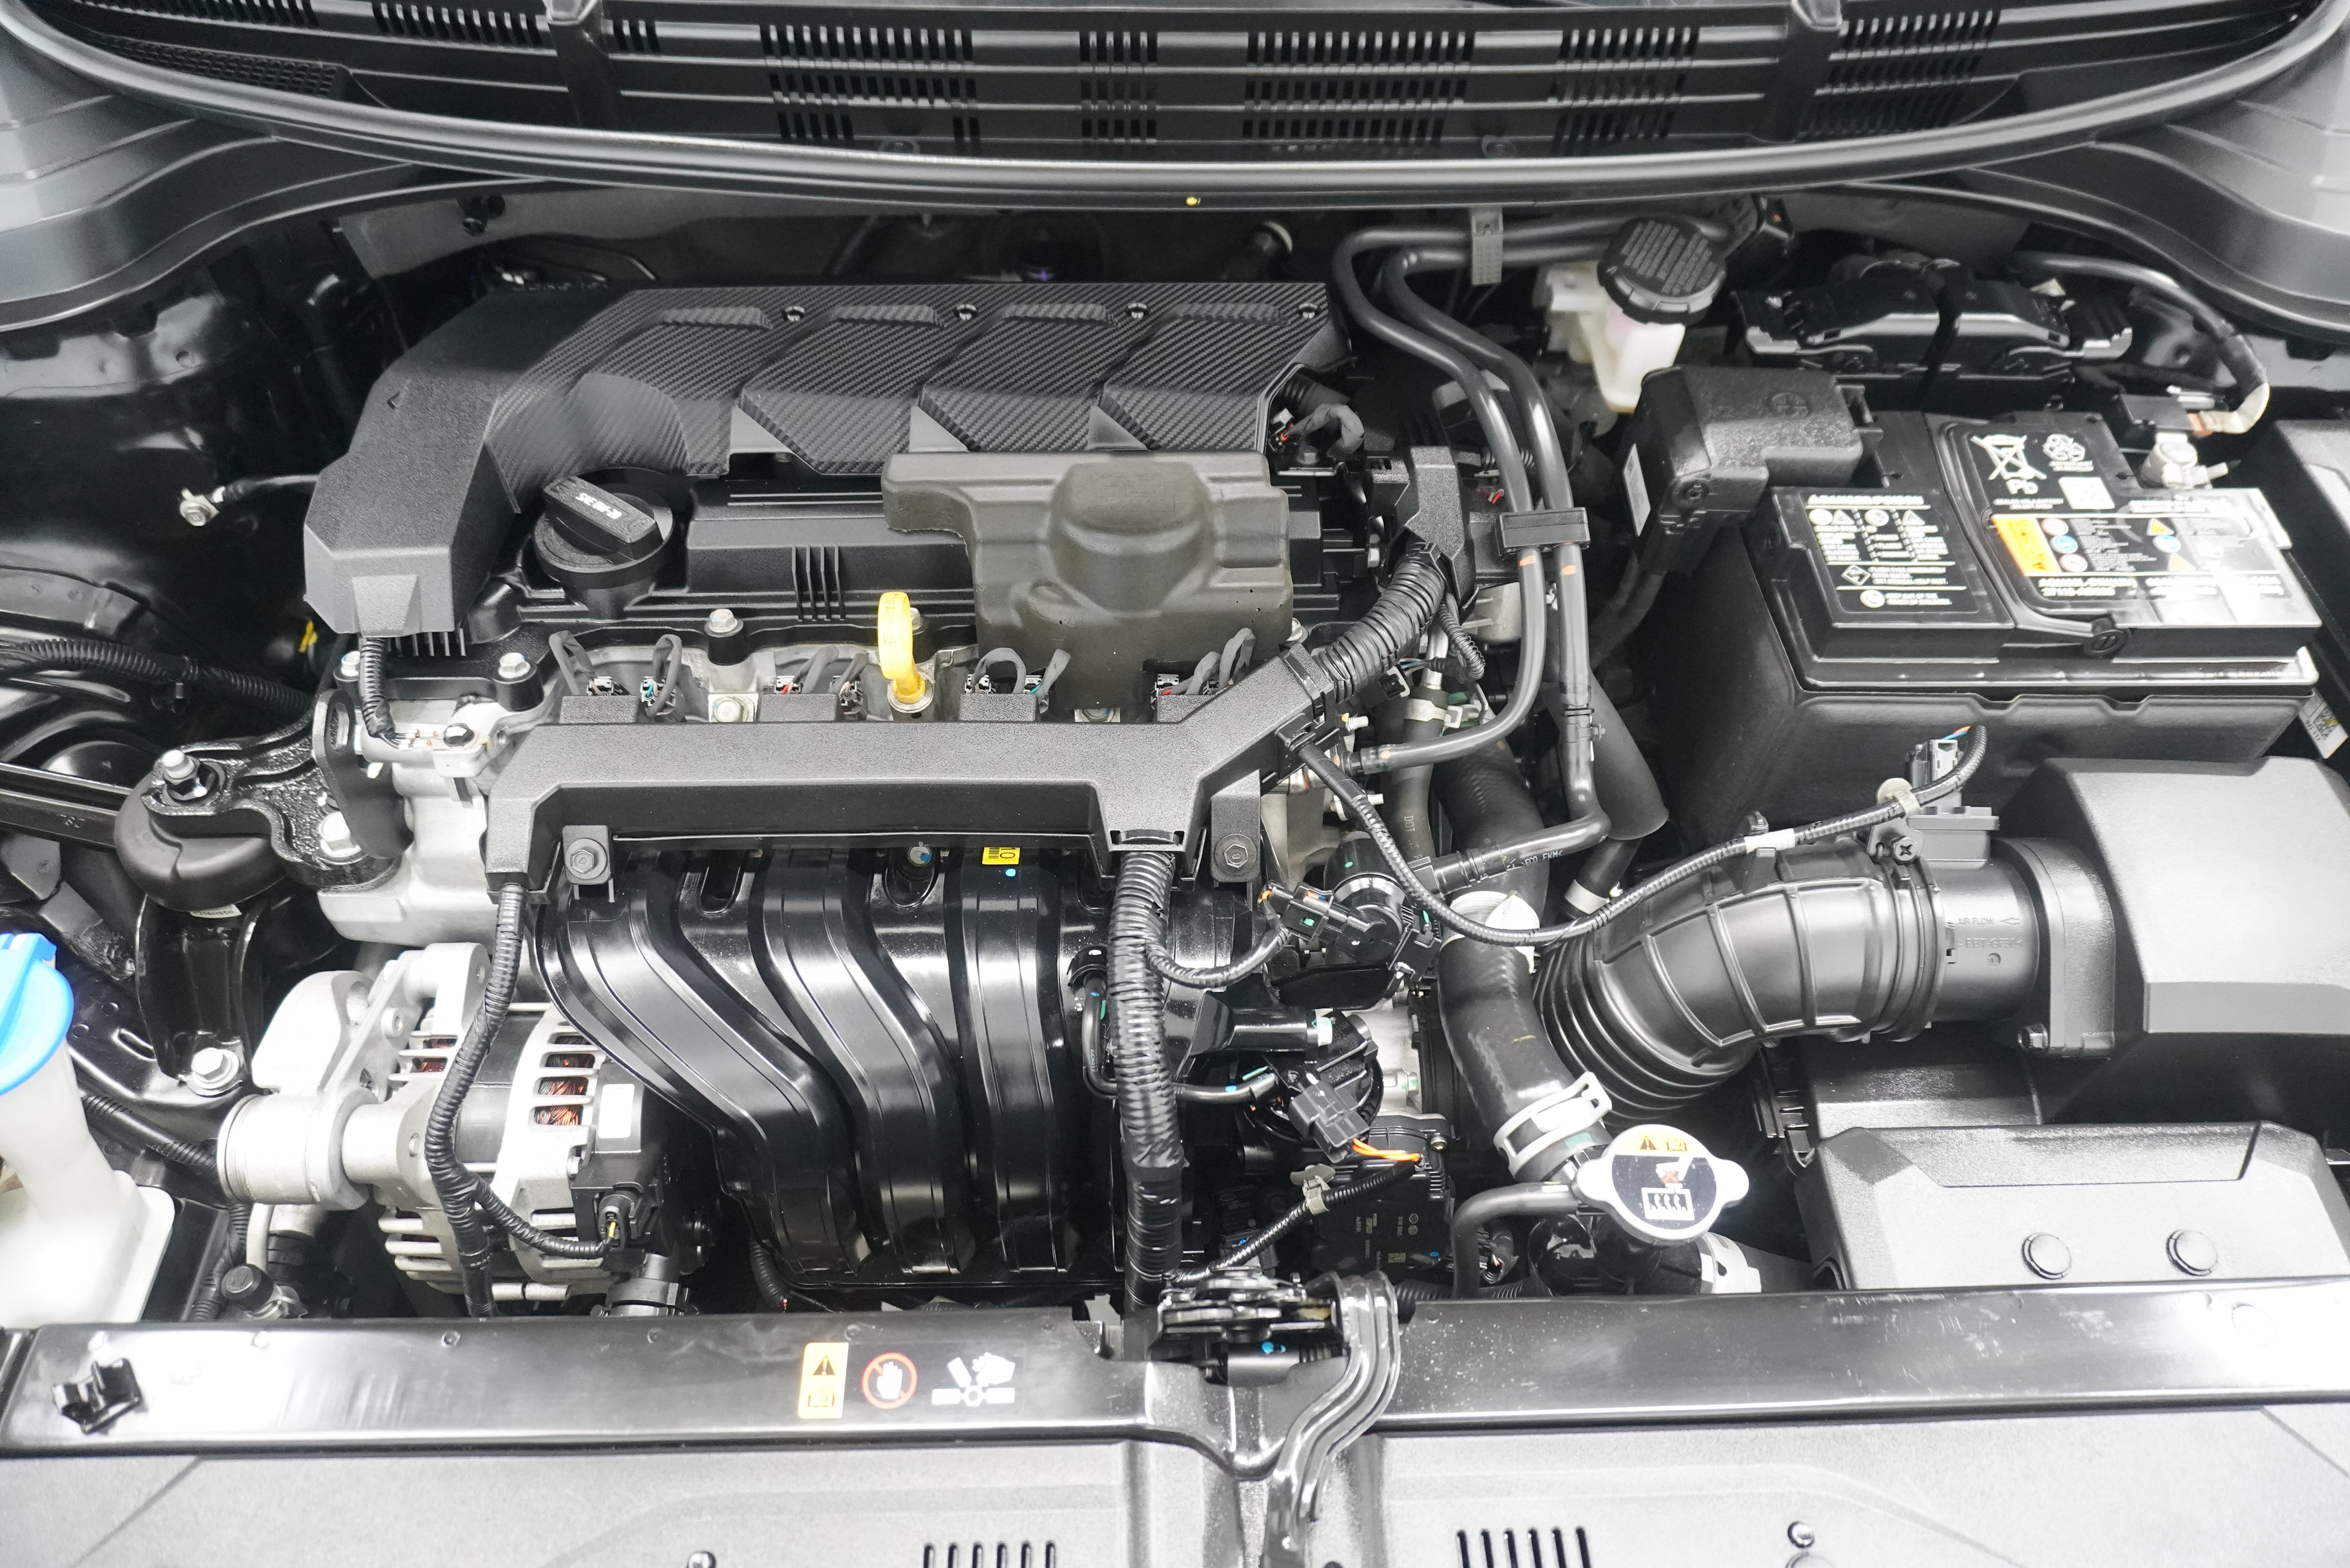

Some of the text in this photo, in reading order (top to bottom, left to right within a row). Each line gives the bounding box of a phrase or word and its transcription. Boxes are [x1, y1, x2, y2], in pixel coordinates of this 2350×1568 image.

[2006, 479, 2038, 494] Pb
[575, 493, 598, 506] SAE
[1404, 815, 1416, 832] DOT
